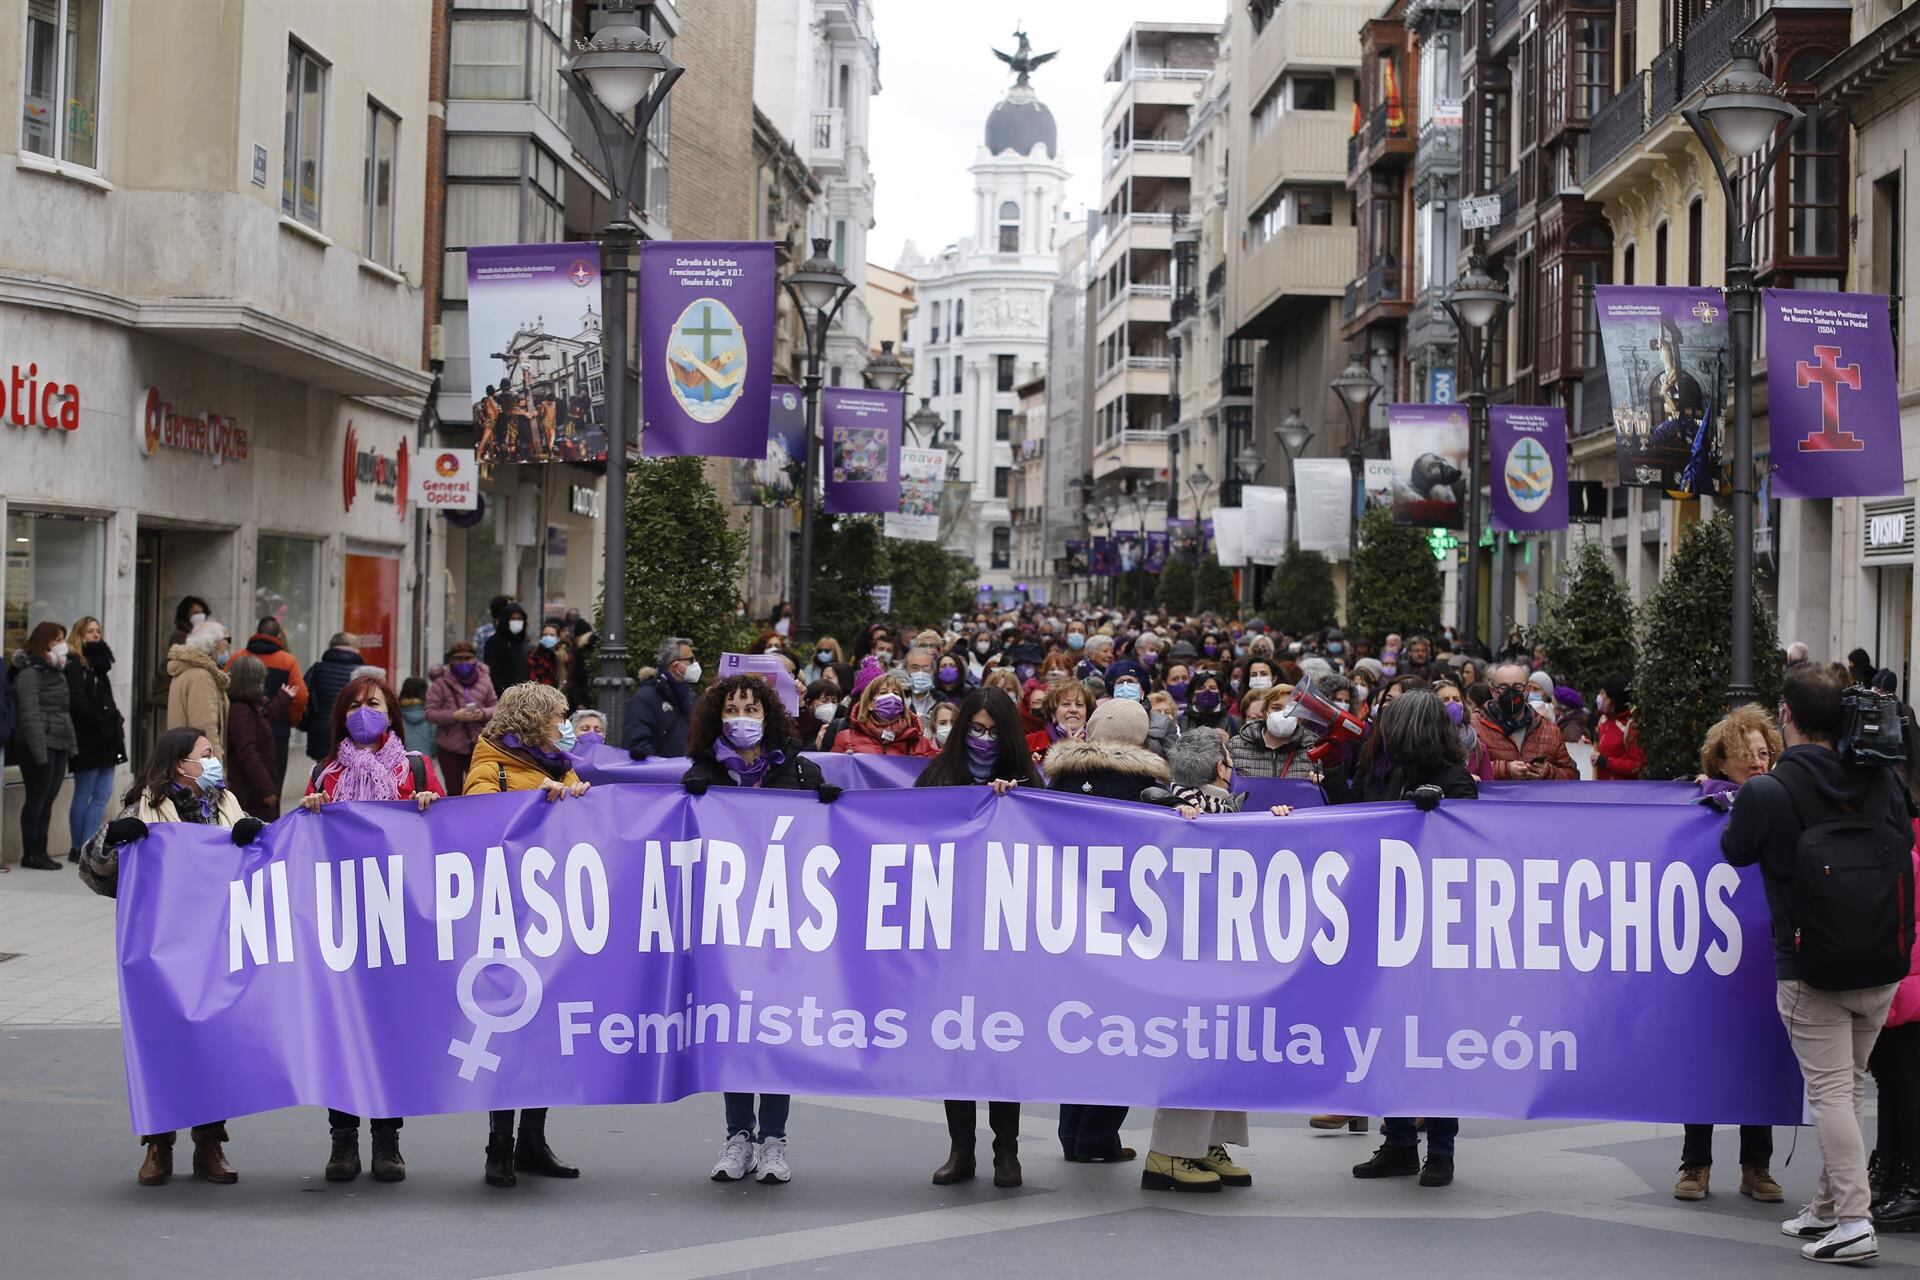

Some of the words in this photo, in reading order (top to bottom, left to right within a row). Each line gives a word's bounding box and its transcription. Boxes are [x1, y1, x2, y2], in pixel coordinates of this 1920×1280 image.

[703, 258, 711, 266] de
[704, 278, 714, 286] del
[1435, 373, 1450, 405] ON
[903, 453, 943, 465] reava
[1369, 464, 1392, 475] cre
[423, 481, 470, 492] General
[427, 492, 466, 505] Optica
[228, 860, 294, 974] NI
[315, 854, 407, 973] UN
[434, 842, 611, 962] PASO
[638, 815, 841, 954] ATRÁS
[865, 841, 956, 952] EN
[983, 841, 1351, 967] NUESTROS
[1377, 838, 1743, 977] DERECHOS
[557, 989, 908, 1056] Feministas
[930, 995, 1025, 1053] de
[1047, 997, 1325, 1067] Castilla
[1343, 1026, 1382, 1084] y
[1404, 1015, 1578, 1072] León
